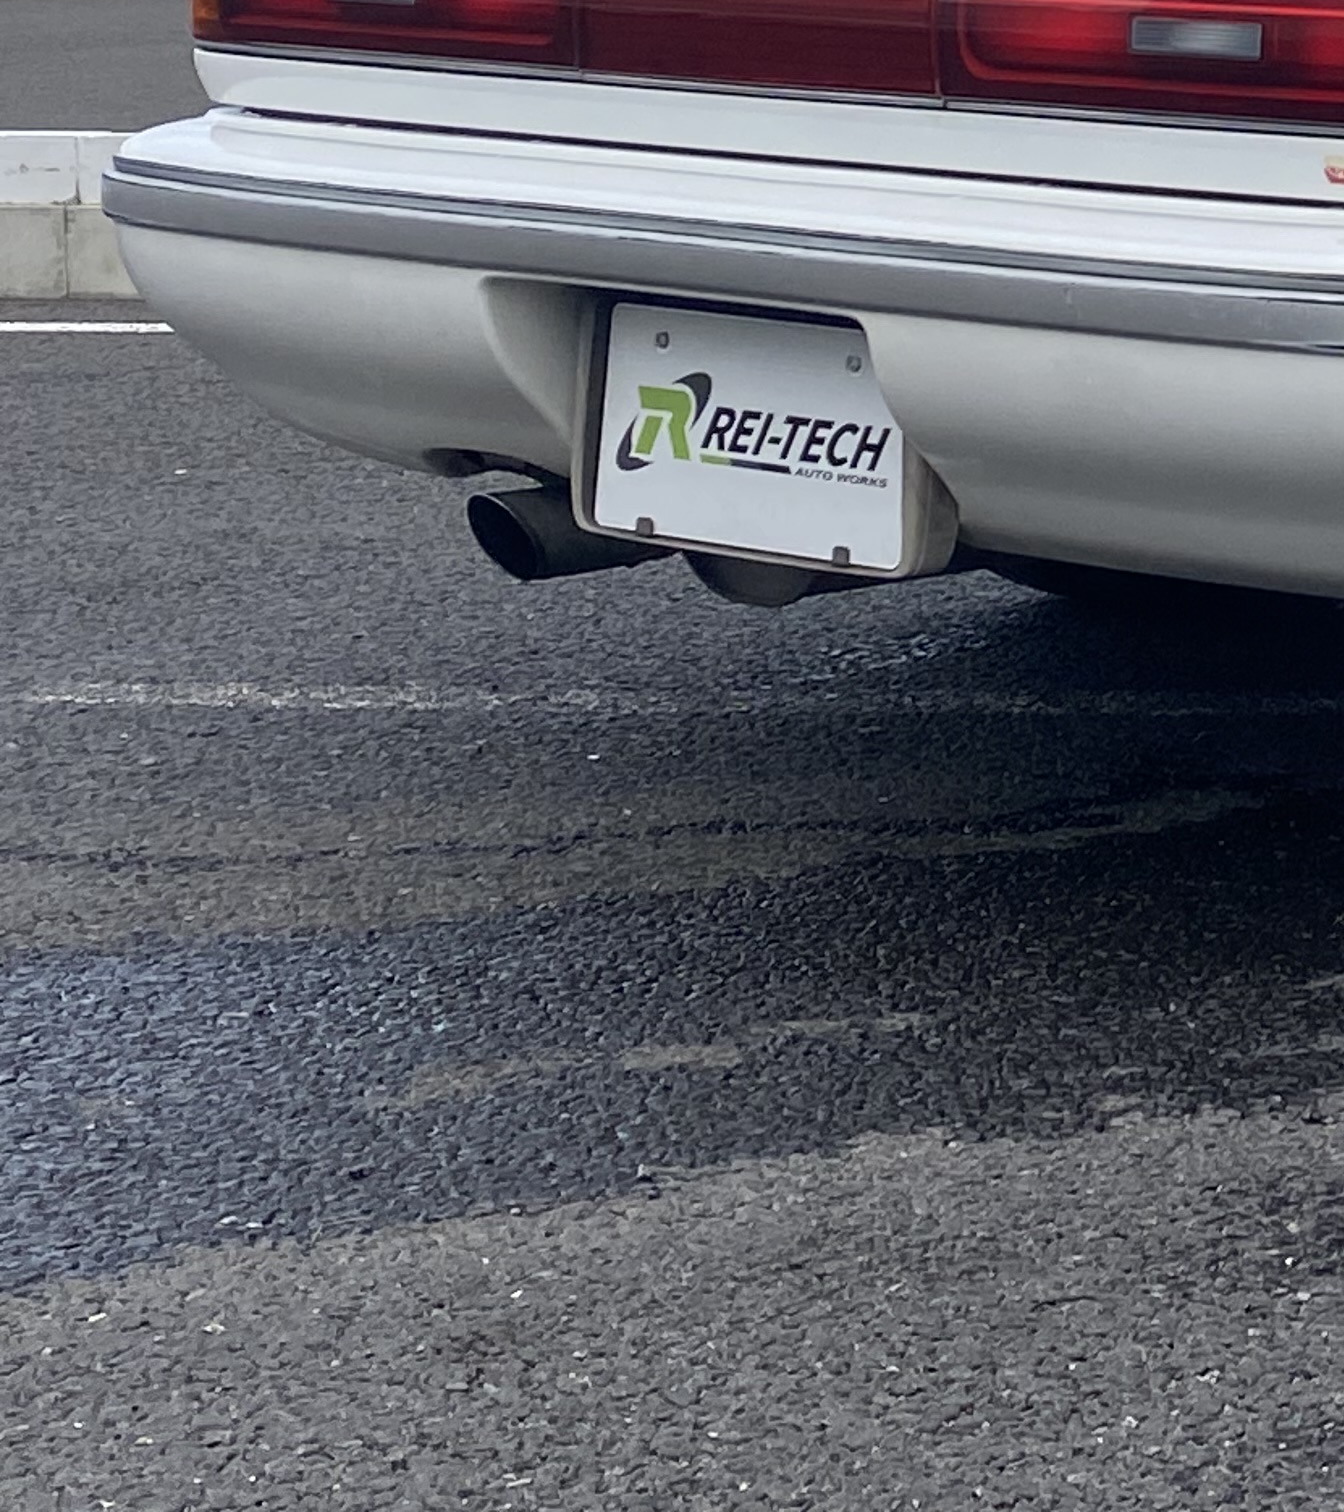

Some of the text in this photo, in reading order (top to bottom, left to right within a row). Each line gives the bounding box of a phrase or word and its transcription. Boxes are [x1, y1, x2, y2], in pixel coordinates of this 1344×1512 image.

[700, 406, 892, 472] REI-TECH
[794, 467, 889, 489] AUTO WORKS
